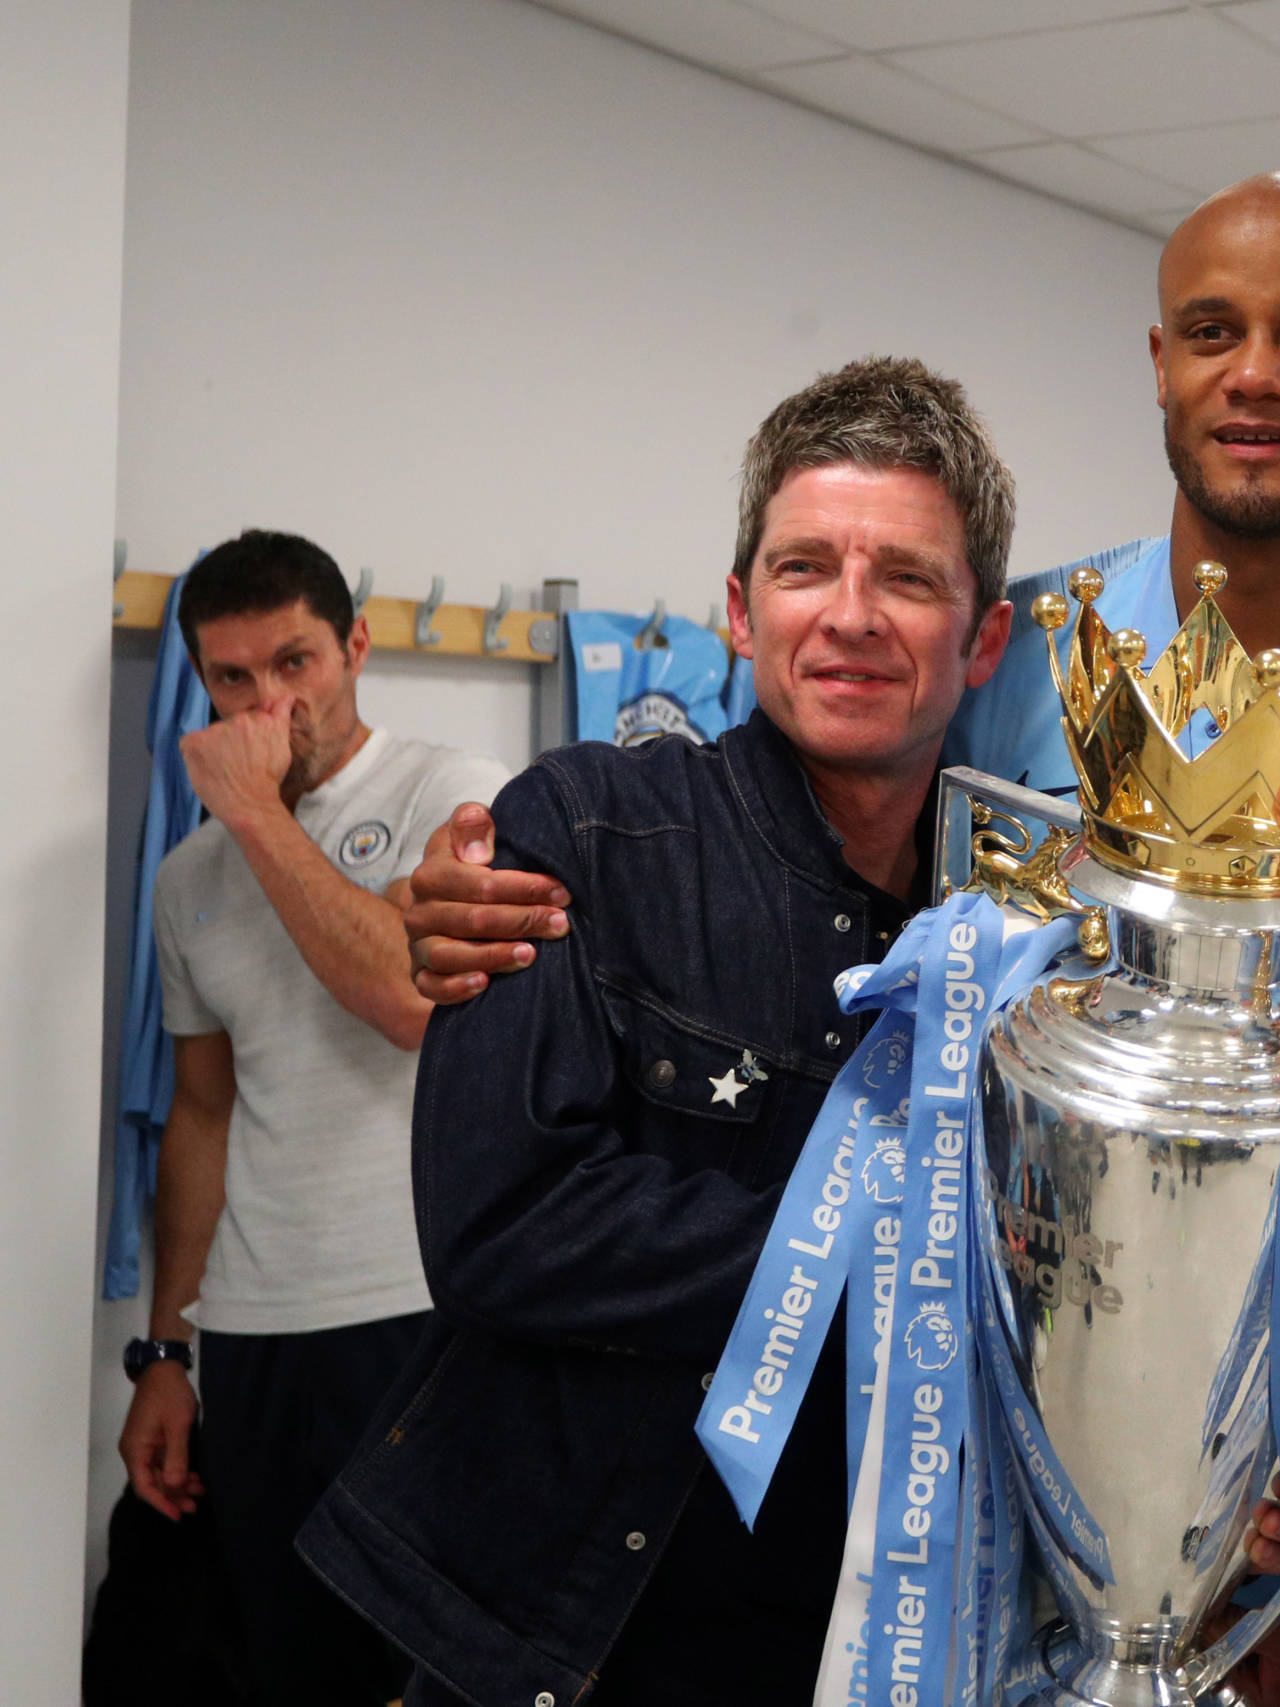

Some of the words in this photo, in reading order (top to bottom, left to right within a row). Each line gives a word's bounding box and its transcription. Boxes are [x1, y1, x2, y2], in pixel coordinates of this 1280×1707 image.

[924, 922, 985, 1099] League
[910, 1112, 964, 1289] Premier
[718, 1265, 819, 1444] Premier
[887, 1384, 950, 1565] League
